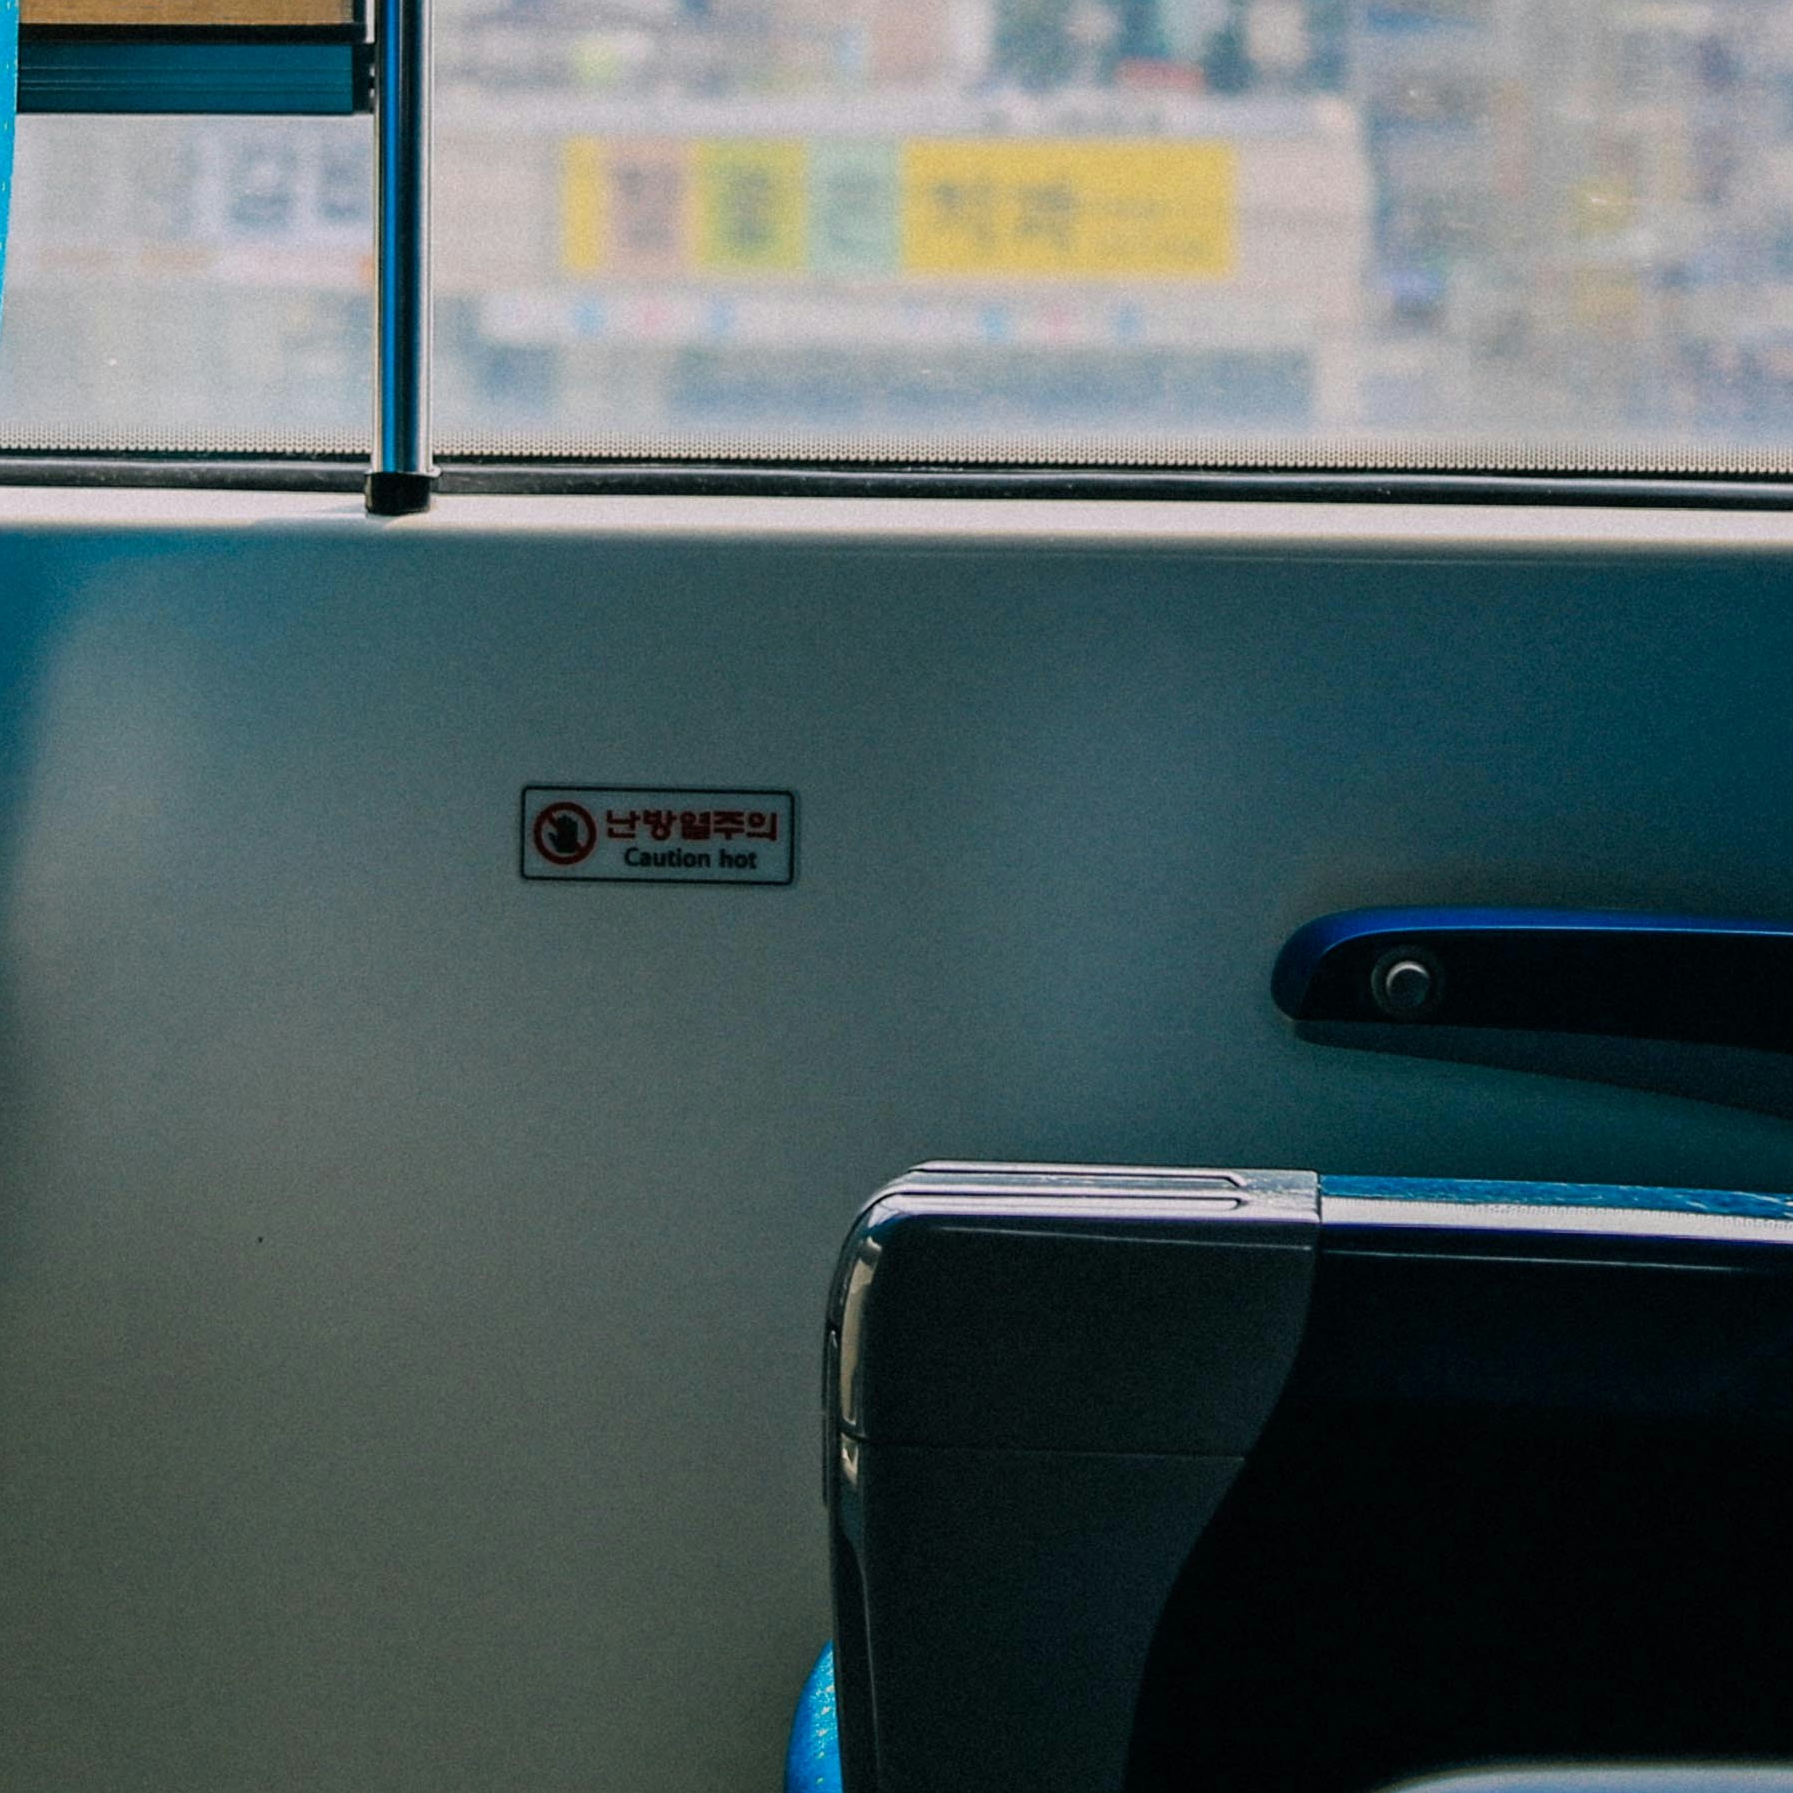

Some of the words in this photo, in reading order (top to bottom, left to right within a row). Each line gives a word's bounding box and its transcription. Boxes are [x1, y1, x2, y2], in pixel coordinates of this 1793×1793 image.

[606, 809, 778, 841] 난방열주의
[623, 847, 711, 869] Caution
[718, 848, 758, 870] hot
